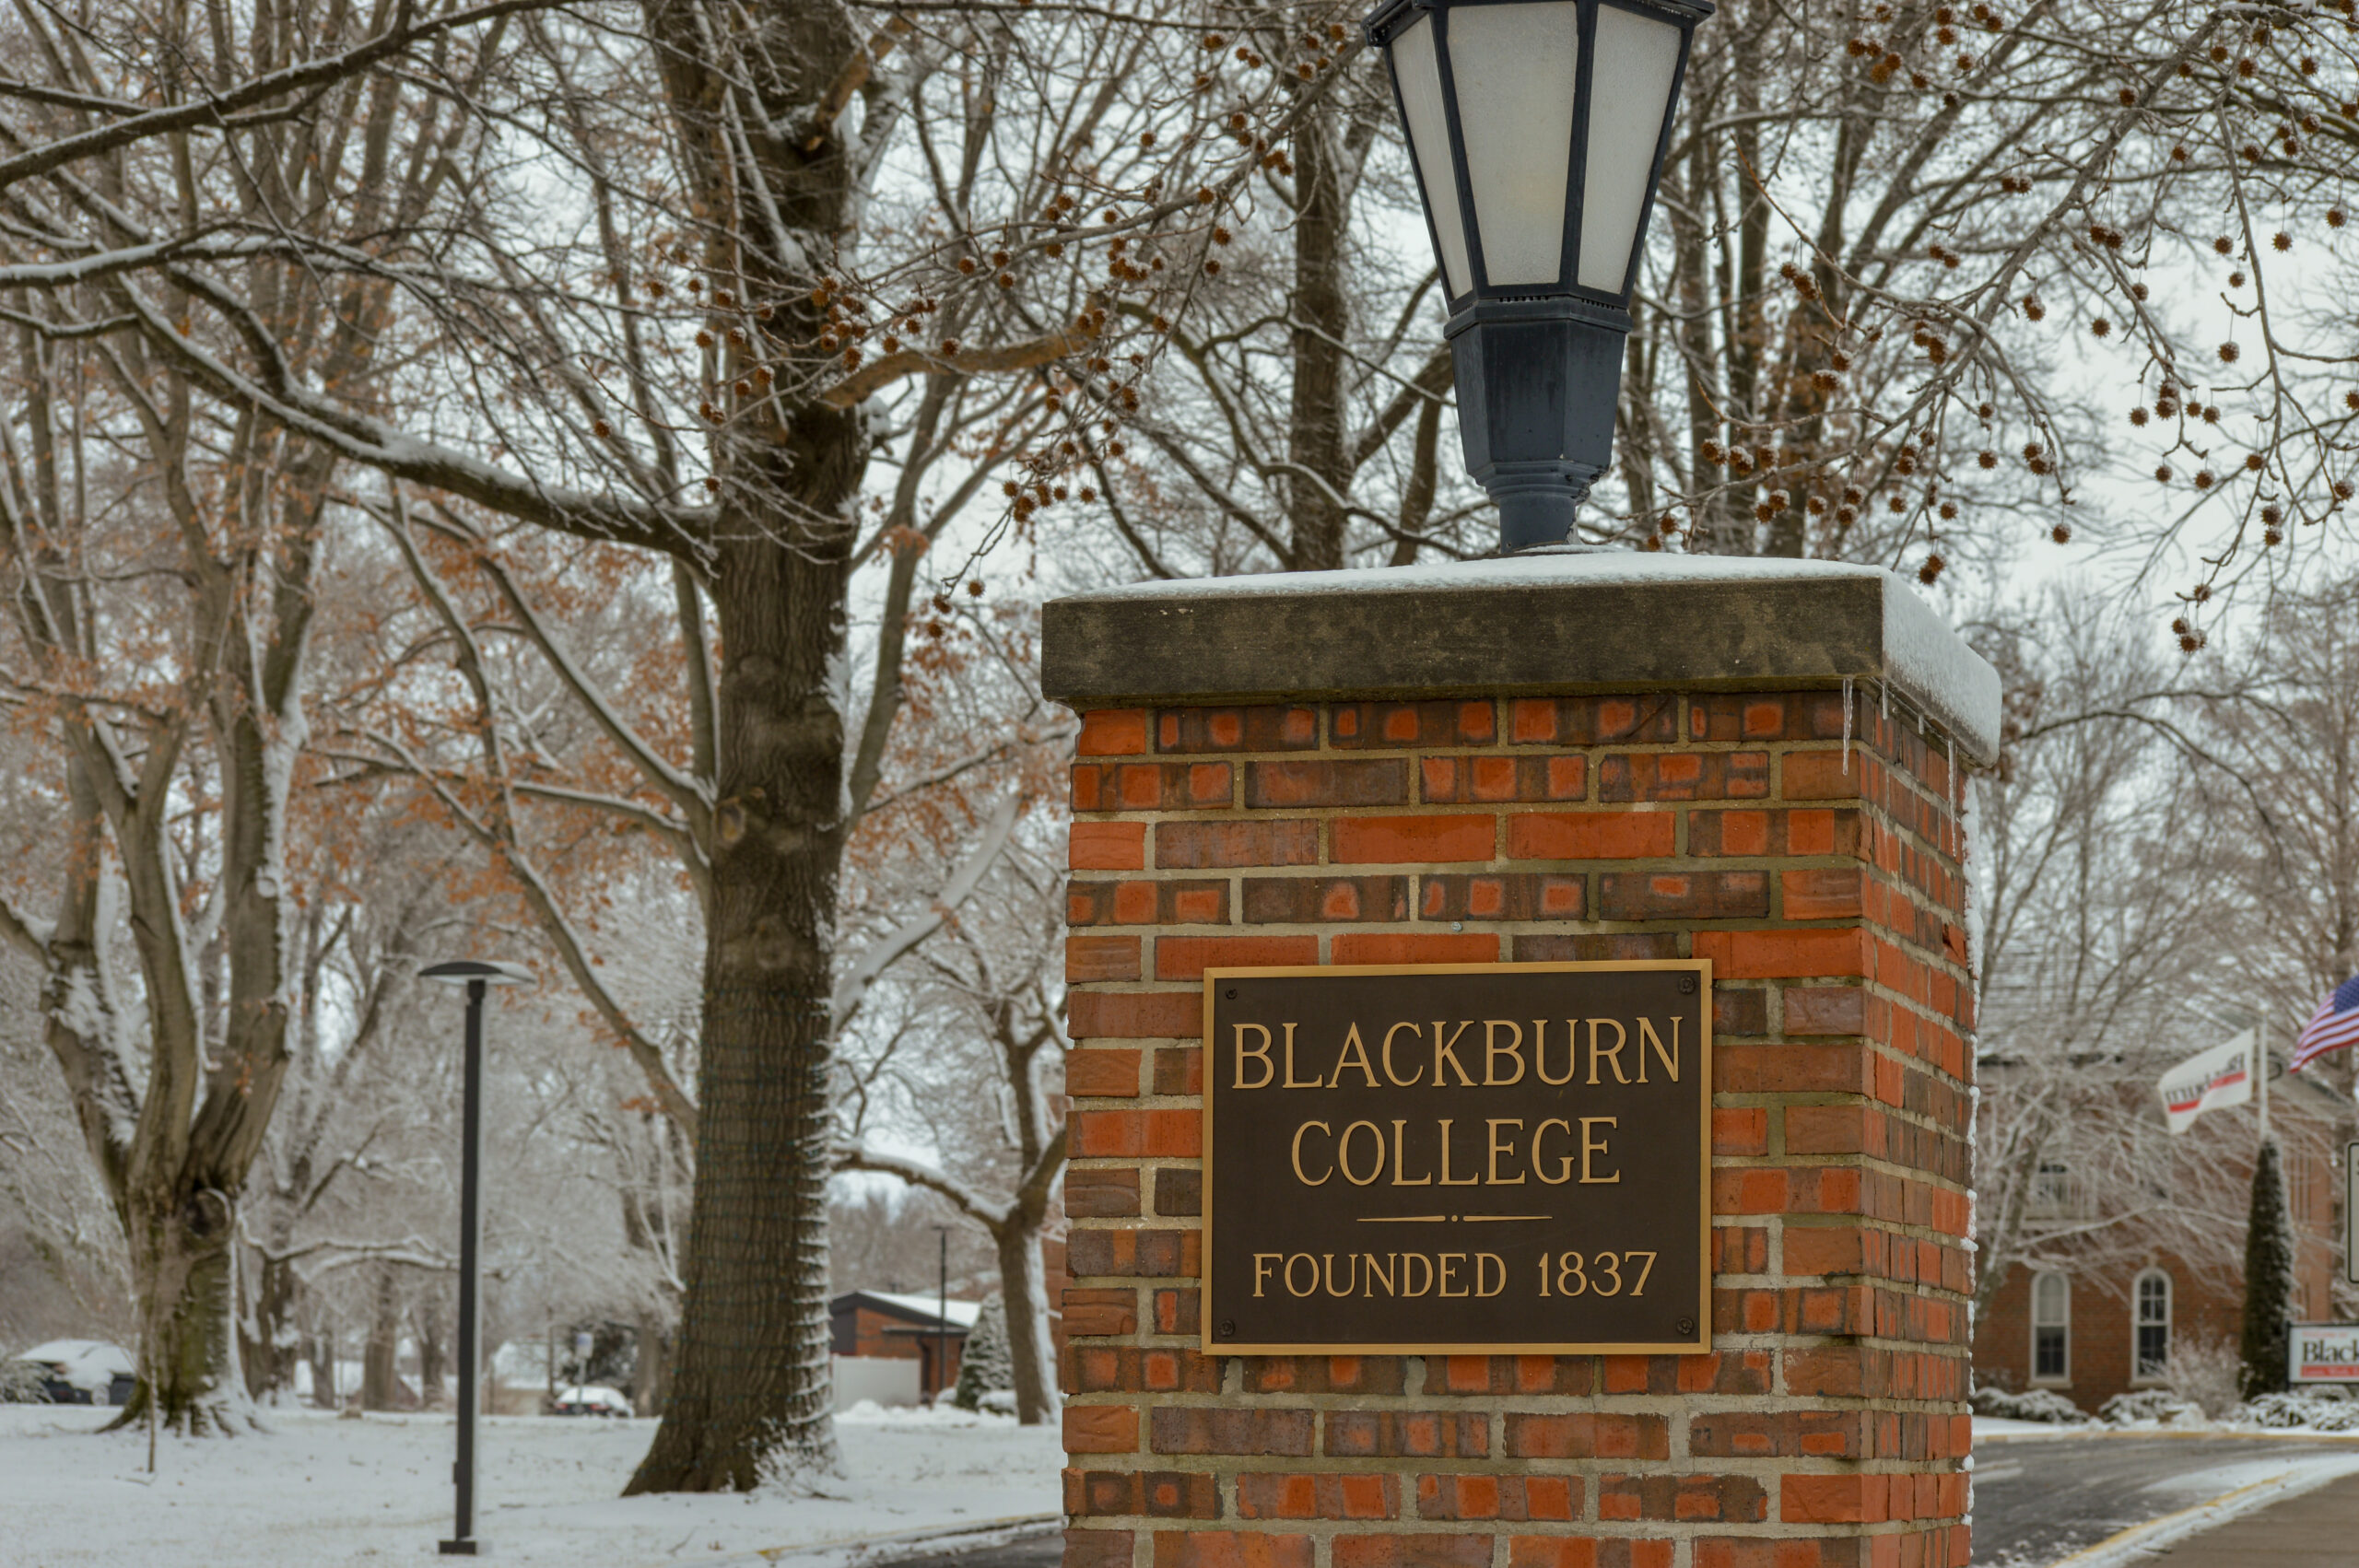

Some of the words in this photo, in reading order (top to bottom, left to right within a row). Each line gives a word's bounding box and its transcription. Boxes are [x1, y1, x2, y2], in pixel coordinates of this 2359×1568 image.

[1231, 1016, 1684, 1089] BLACKBURN
[1291, 1116, 1620, 1187] COLLEGE
[1252, 1252, 1507, 1298] FOUNDED
[1538, 1251, 1658, 1297] 1837
